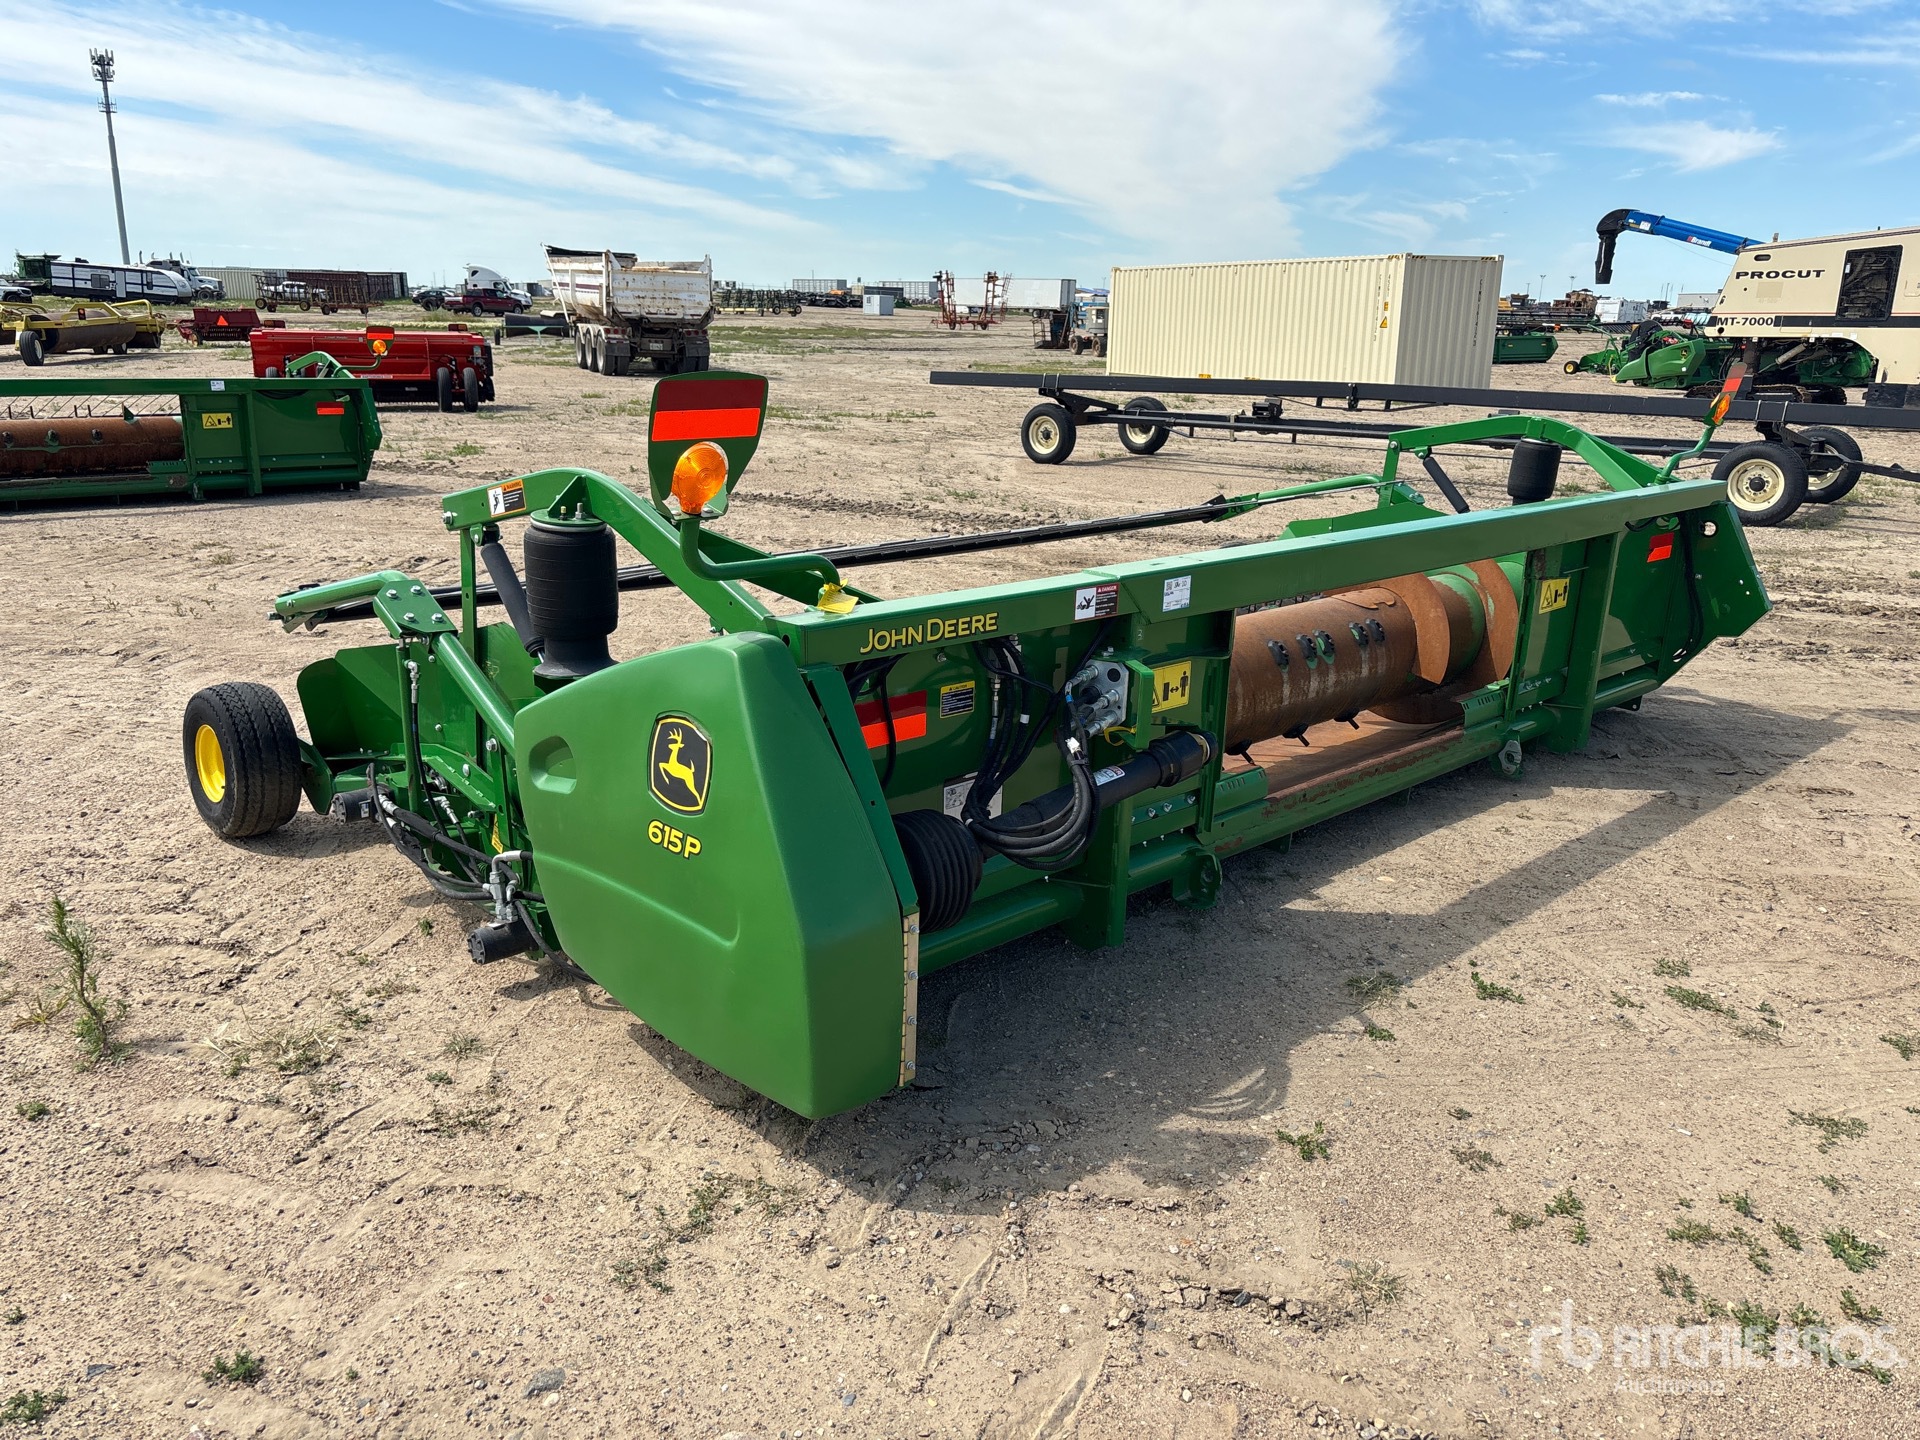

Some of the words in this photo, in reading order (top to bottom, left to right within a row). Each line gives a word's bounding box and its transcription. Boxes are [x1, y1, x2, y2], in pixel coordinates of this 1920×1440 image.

[1690, 236, 1712, 247] Brandt
[1735, 269, 1826, 280] PROCUT
[1716, 317, 1774, 326] MT-7000
[859, 624, 923, 654] JOHN
[926, 612, 999, 642] DEERE
[647, 819, 703, 860] 615P
